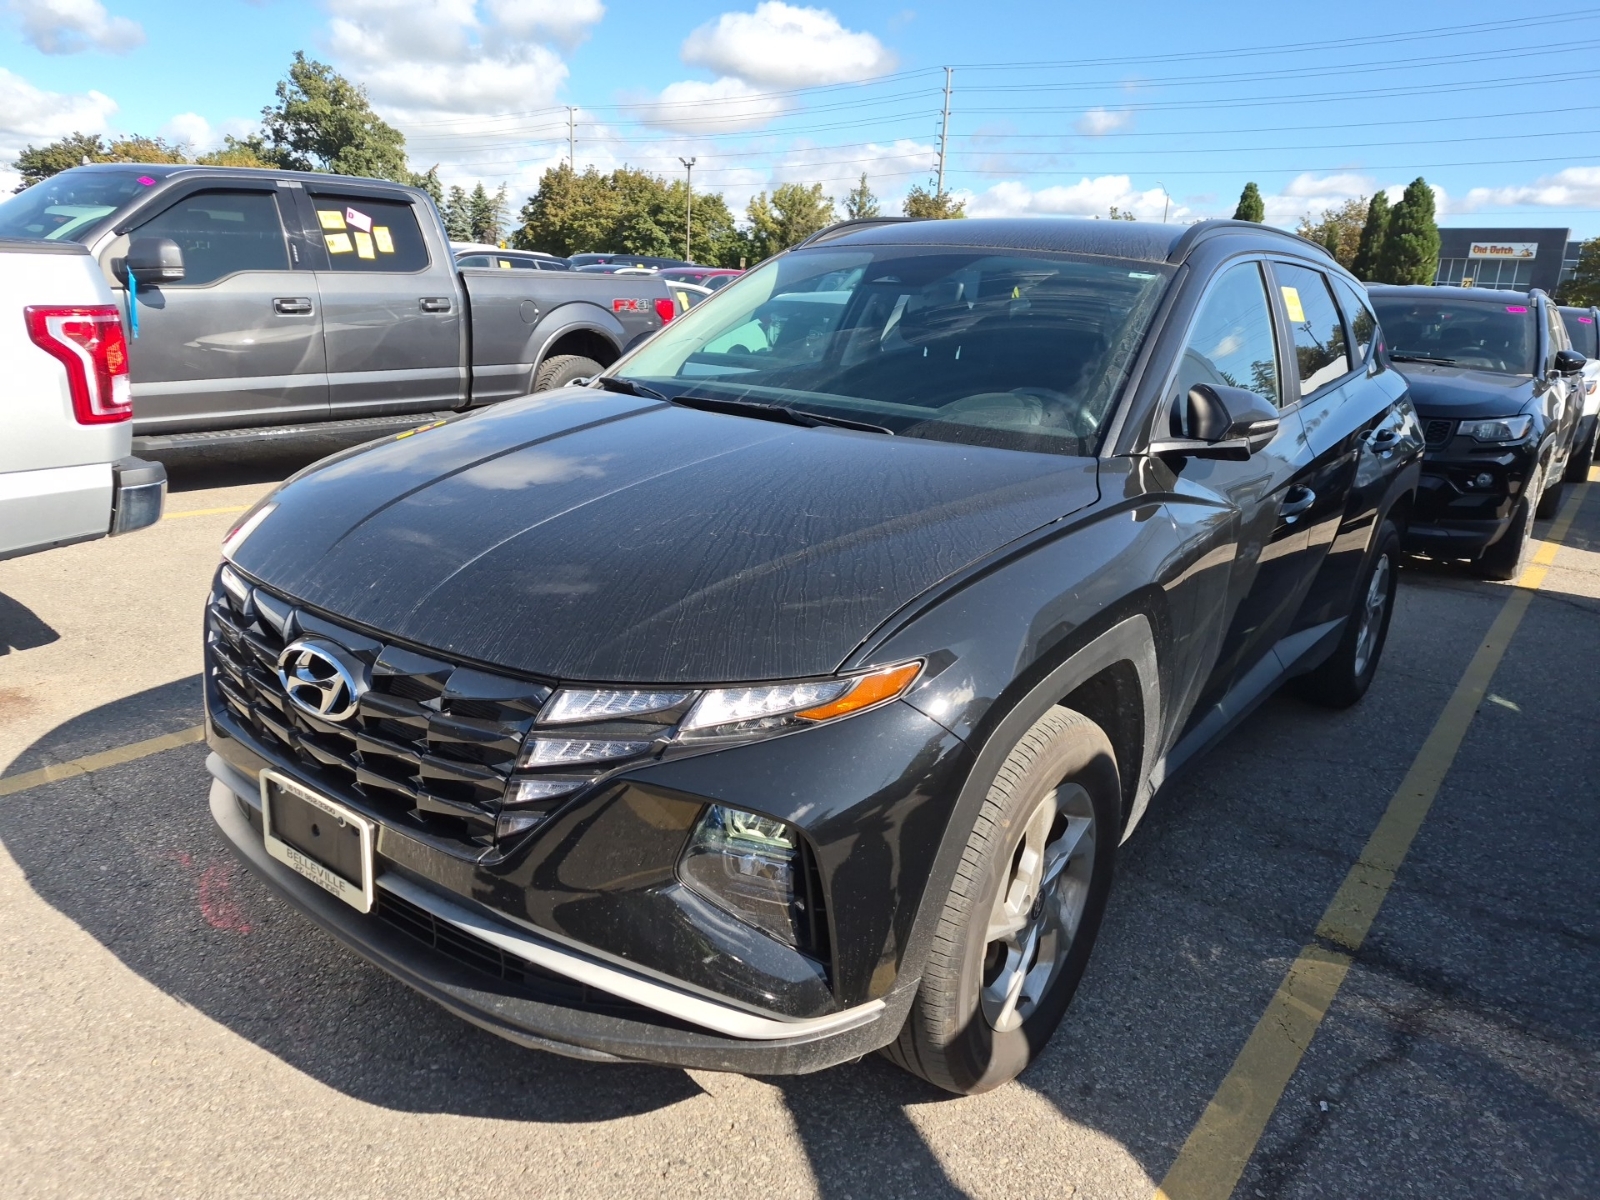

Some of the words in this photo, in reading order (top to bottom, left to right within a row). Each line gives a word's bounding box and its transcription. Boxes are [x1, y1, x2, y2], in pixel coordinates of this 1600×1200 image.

[1473, 244, 1488, 254] Old
[1489, 245, 1514, 254] Dutch
[286, 847, 346, 893] BELLEVILLE
